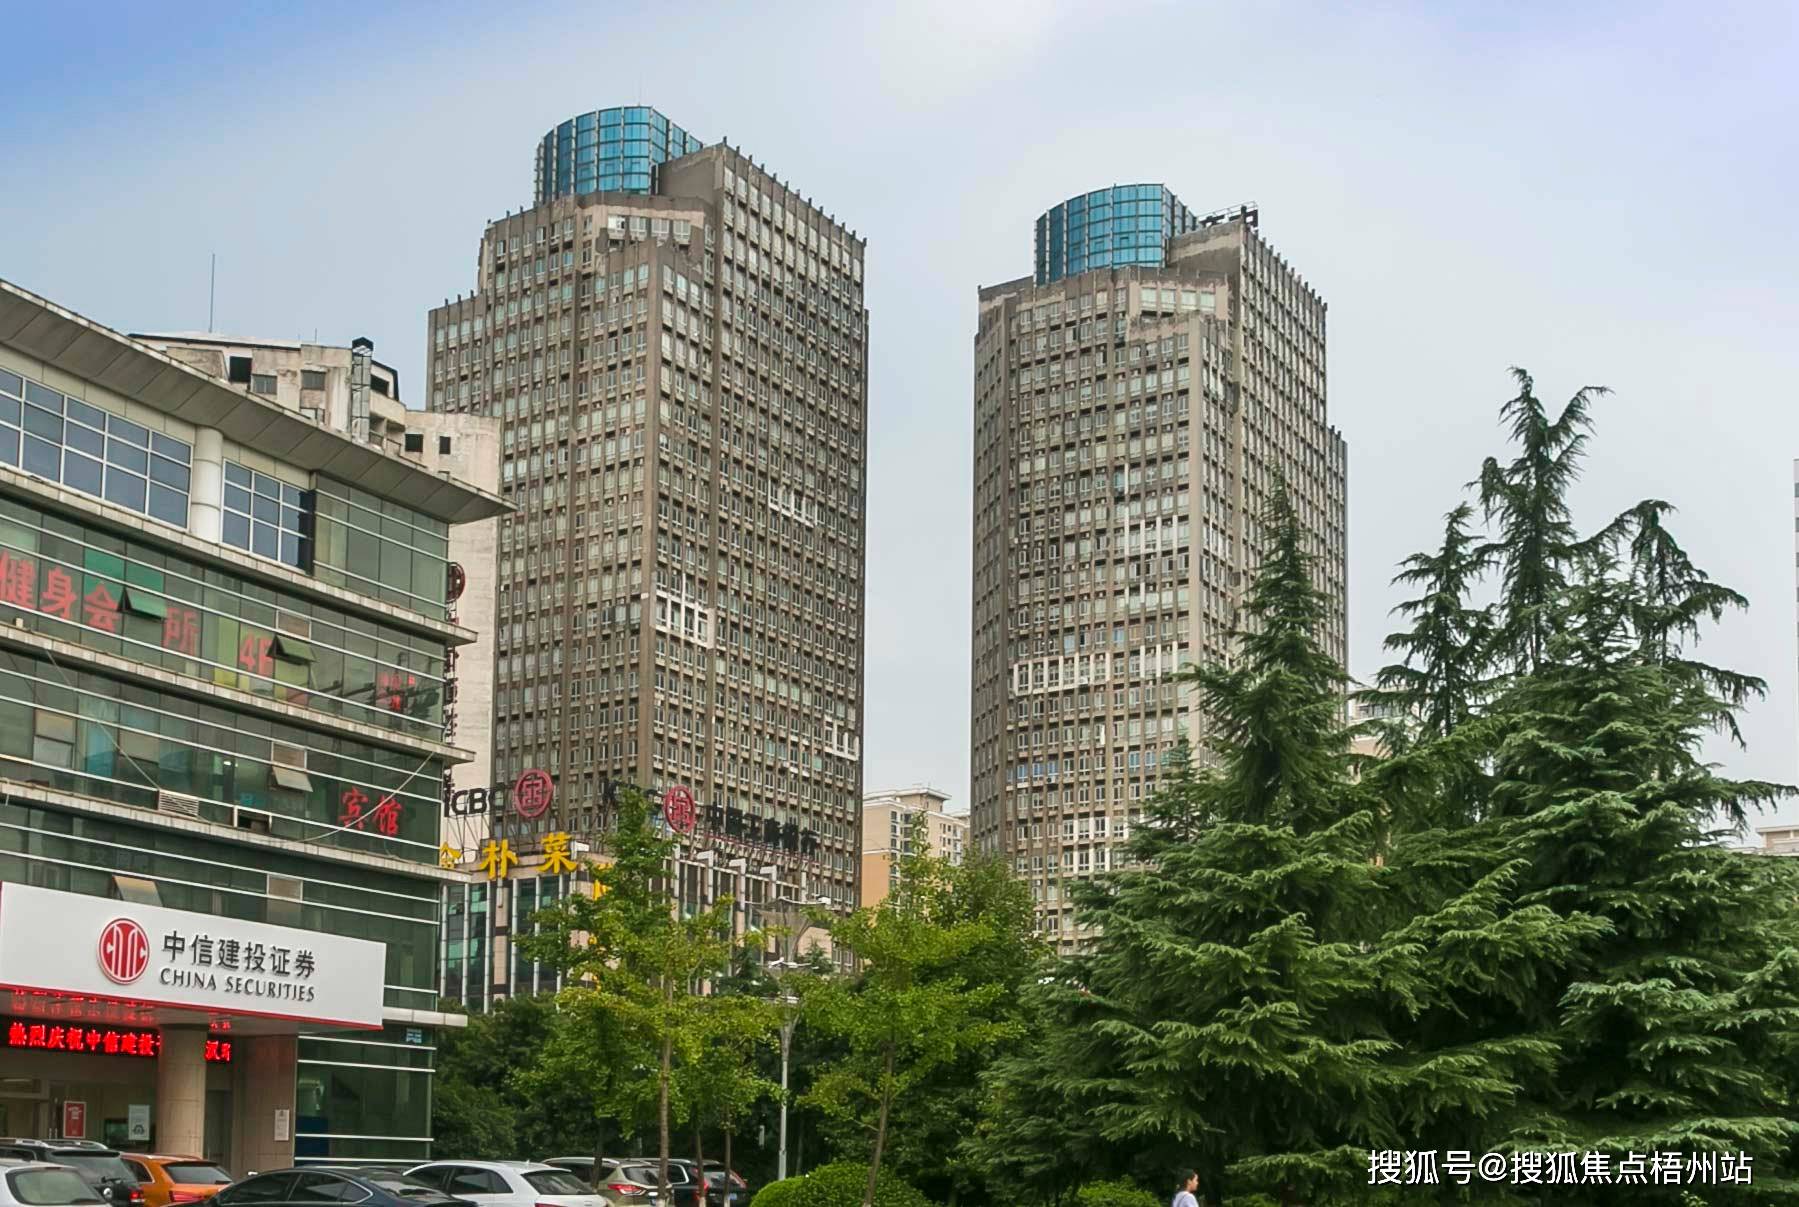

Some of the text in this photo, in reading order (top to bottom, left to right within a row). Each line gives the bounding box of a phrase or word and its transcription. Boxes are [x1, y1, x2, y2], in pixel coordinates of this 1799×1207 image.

[0, 553, 200, 656] 健身会所
[338, 787, 402, 836] 宾馆
[445, 782, 505, 818] ICBC
[162, 930, 316, 979] 中信建投证券
[160, 967, 315, 1002] CHINA SECURITIES
[8, 1021, 161, 1057] 热烈庆祝中信建投
